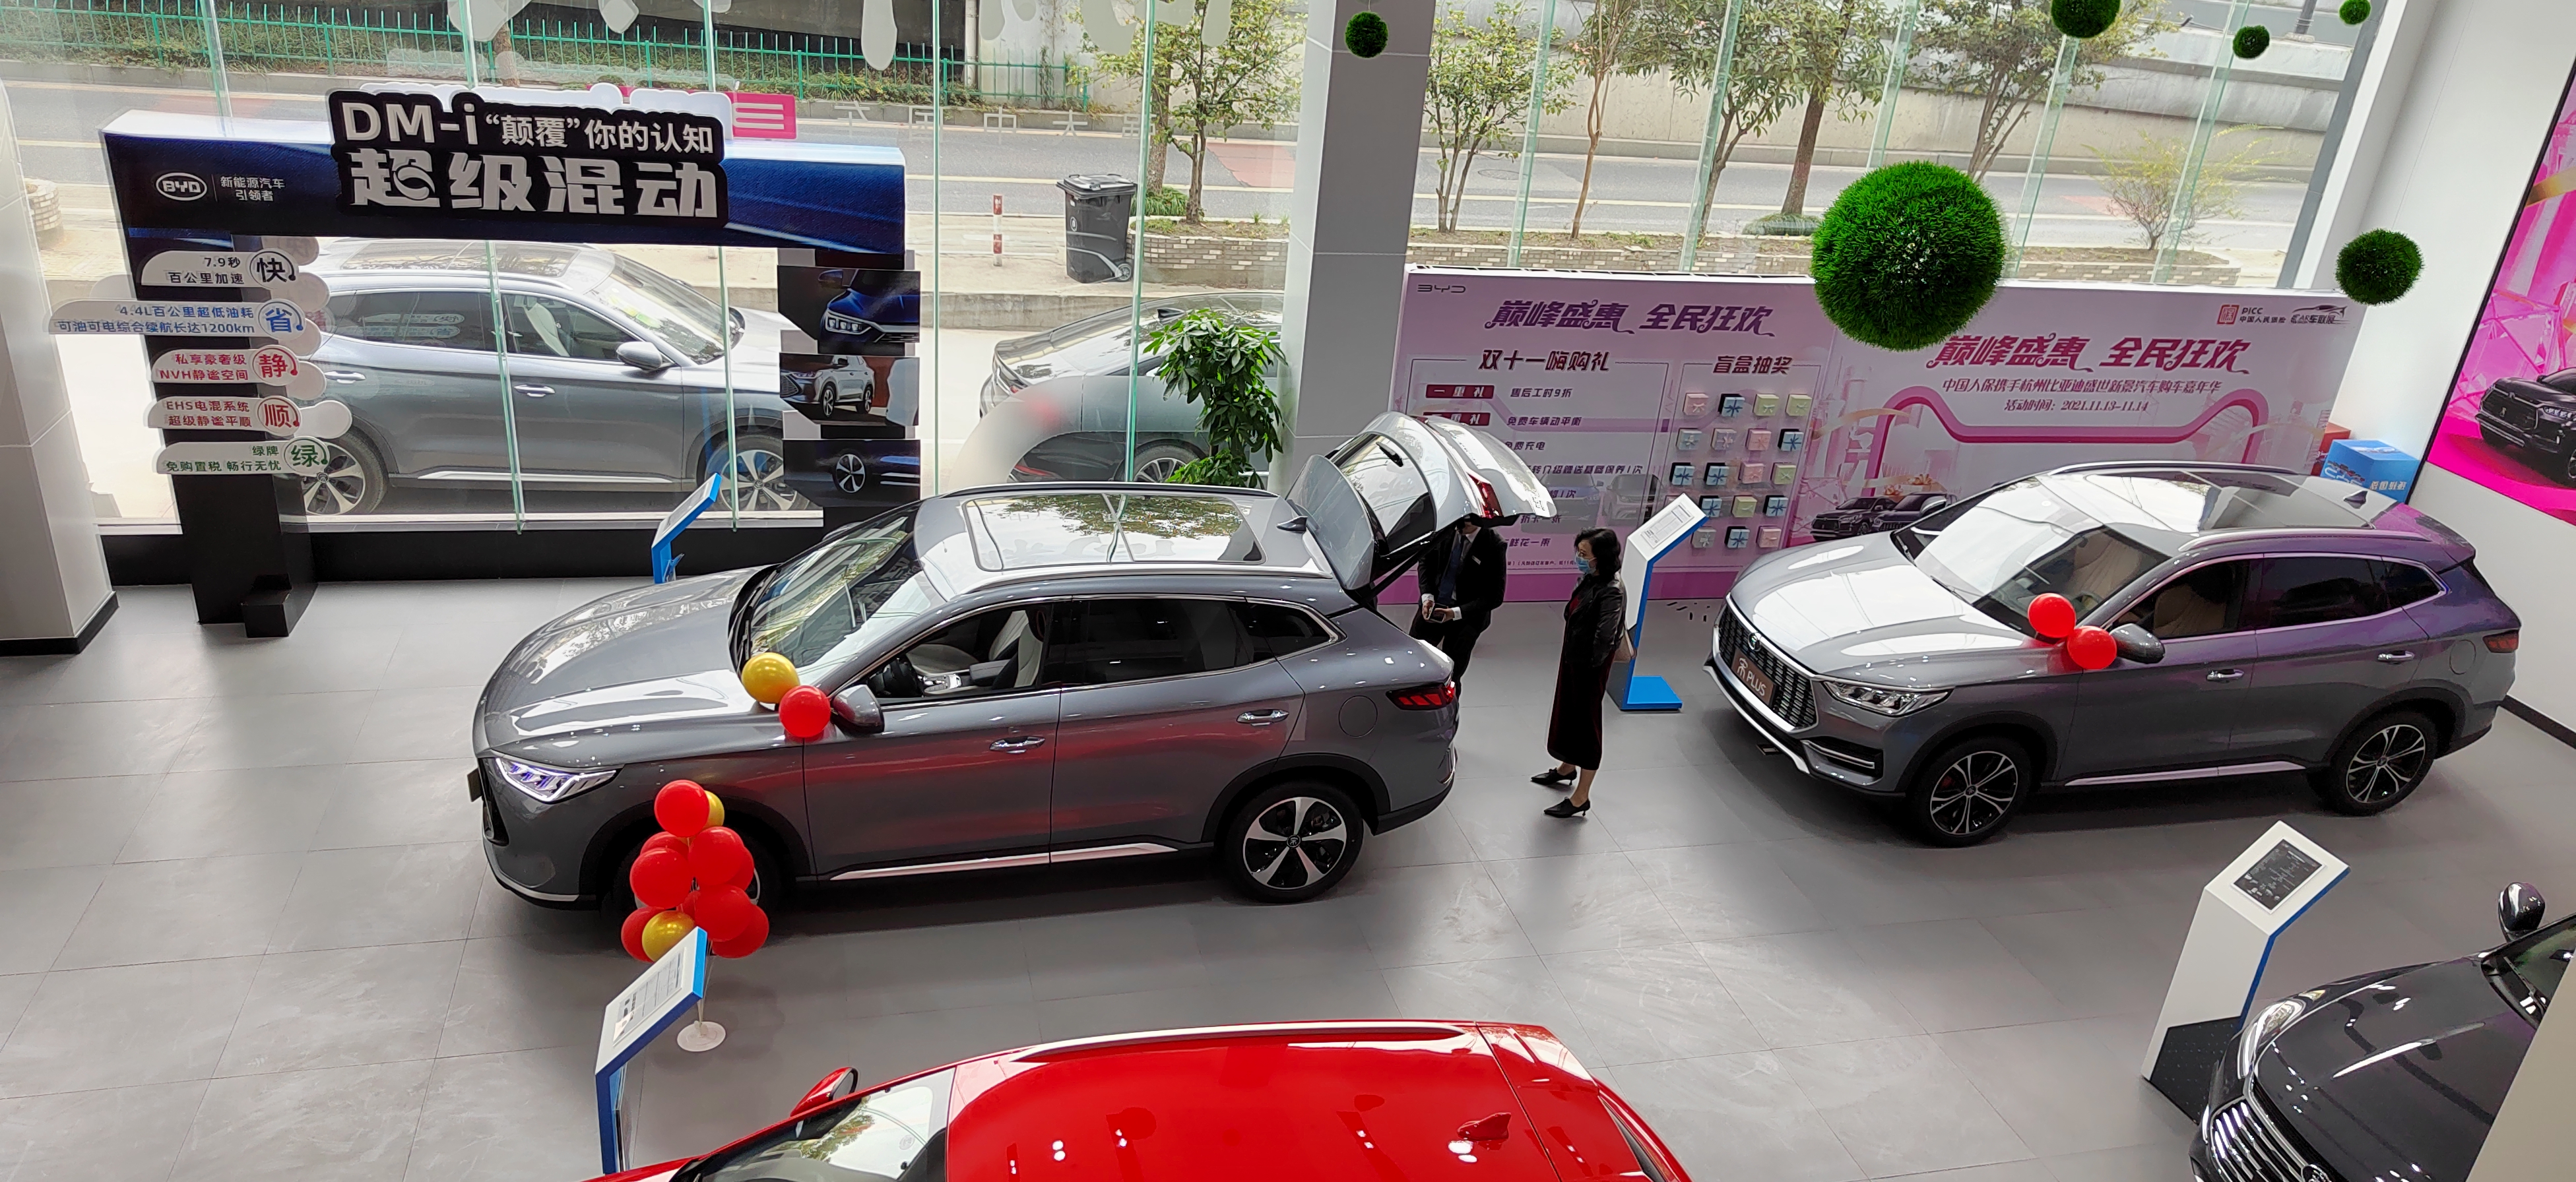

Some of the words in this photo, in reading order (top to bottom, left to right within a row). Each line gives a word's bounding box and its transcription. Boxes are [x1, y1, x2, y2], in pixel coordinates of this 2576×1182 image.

[342, 102, 478, 145] DM-i
[162, 179, 202, 194] BYD
[220, 176, 285, 189] 新能源汽车
[350, 148, 718, 218] 超级混动
[236, 190, 274, 202] 引领者
[204, 257, 241, 268] 7.9秒
[257, 257, 288, 282] 快
[168, 271, 245, 285] 百公里加速
[119, 306, 255, 319] 4.4L百公里超低油耗
[265, 307, 293, 333] 省
[1485, 299, 1634, 334] 巅峰盛惠
[1639, 303, 1775, 337] 全民狂欢
[174, 354, 247, 366] 私享豪奢级
[1478, 350, 1611, 371] 双十一嗨购礼
[1926, 332, 2093, 373] 巅峰盛惠
[2098, 336, 2253, 375] 全民狂欢
[258, 354, 288, 378] 静
[1712, 356, 1793, 375] 盲盒抽奖
[160, 369, 249, 381] NVH静谧空间
[166, 400, 249, 412] EHS电混系统
[168, 416, 252, 427] 超级静谧平顺
[264, 404, 292, 429] 顺
[252, 445, 280, 457] 绿牌
[290, 445, 321, 468] 绿
[166, 461, 222, 472] 免购置税
[226, 460, 282, 472] 畅行无忧
[1746, 669, 1767, 697] PLUS
